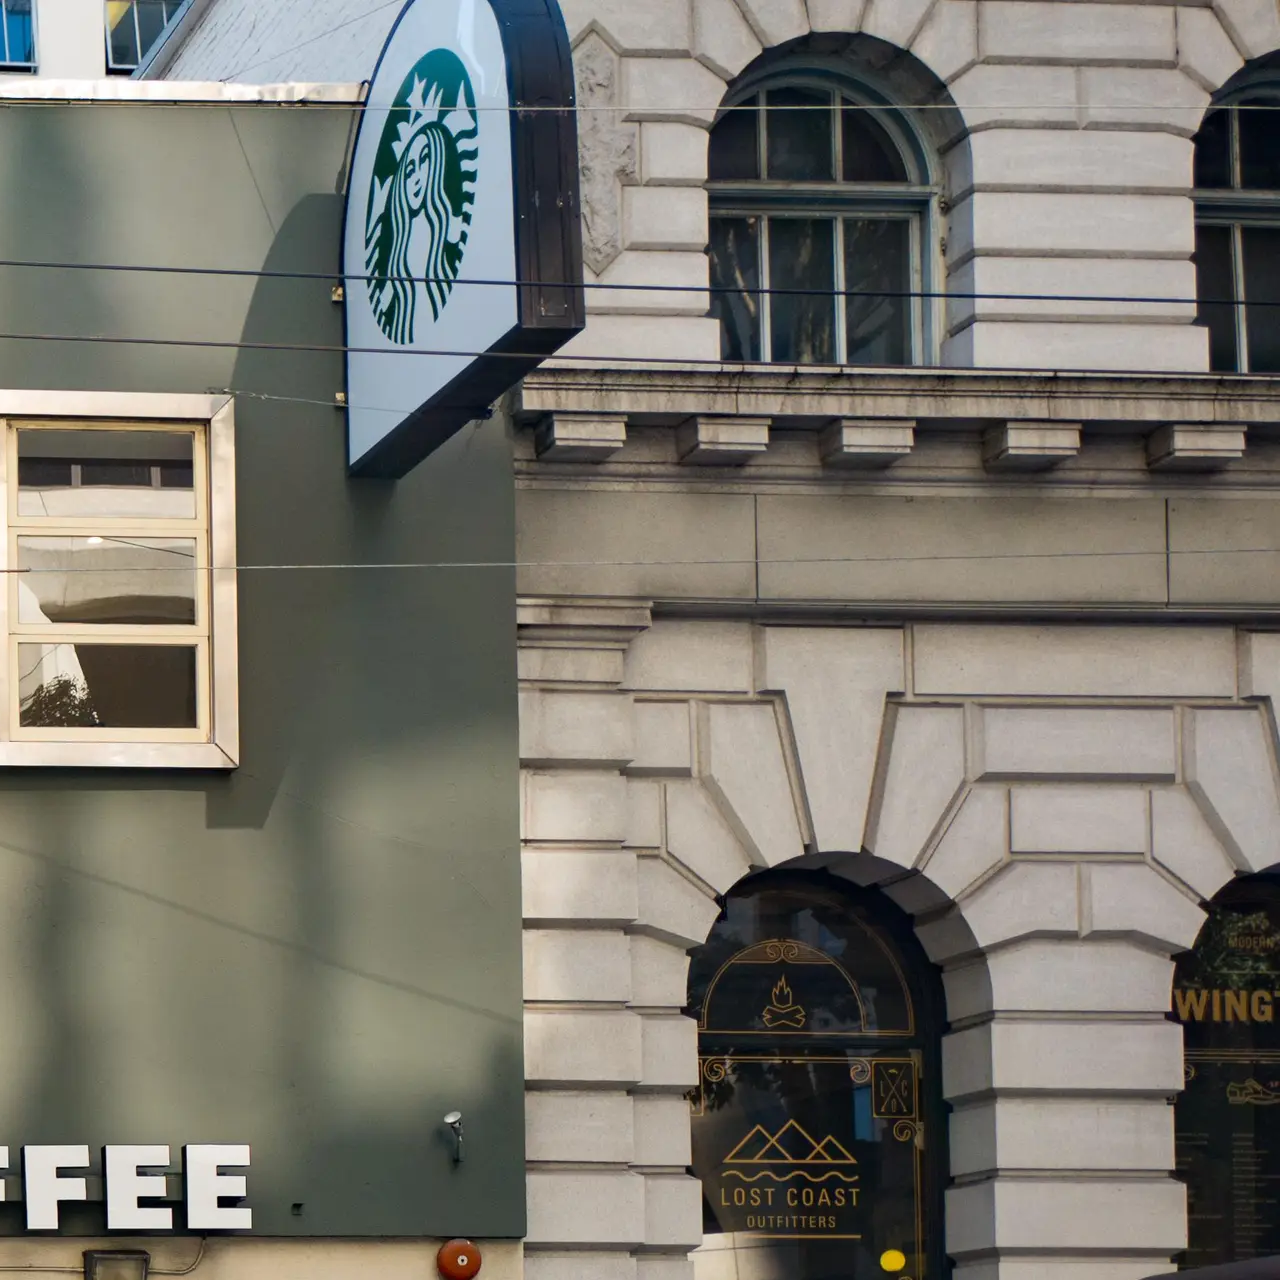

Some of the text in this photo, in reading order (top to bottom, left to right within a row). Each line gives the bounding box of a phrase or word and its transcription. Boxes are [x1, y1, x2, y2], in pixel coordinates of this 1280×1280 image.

[721, 1187, 860, 1207] LOST COAST
[746, 1215, 836, 1228] OUTFITTERS
